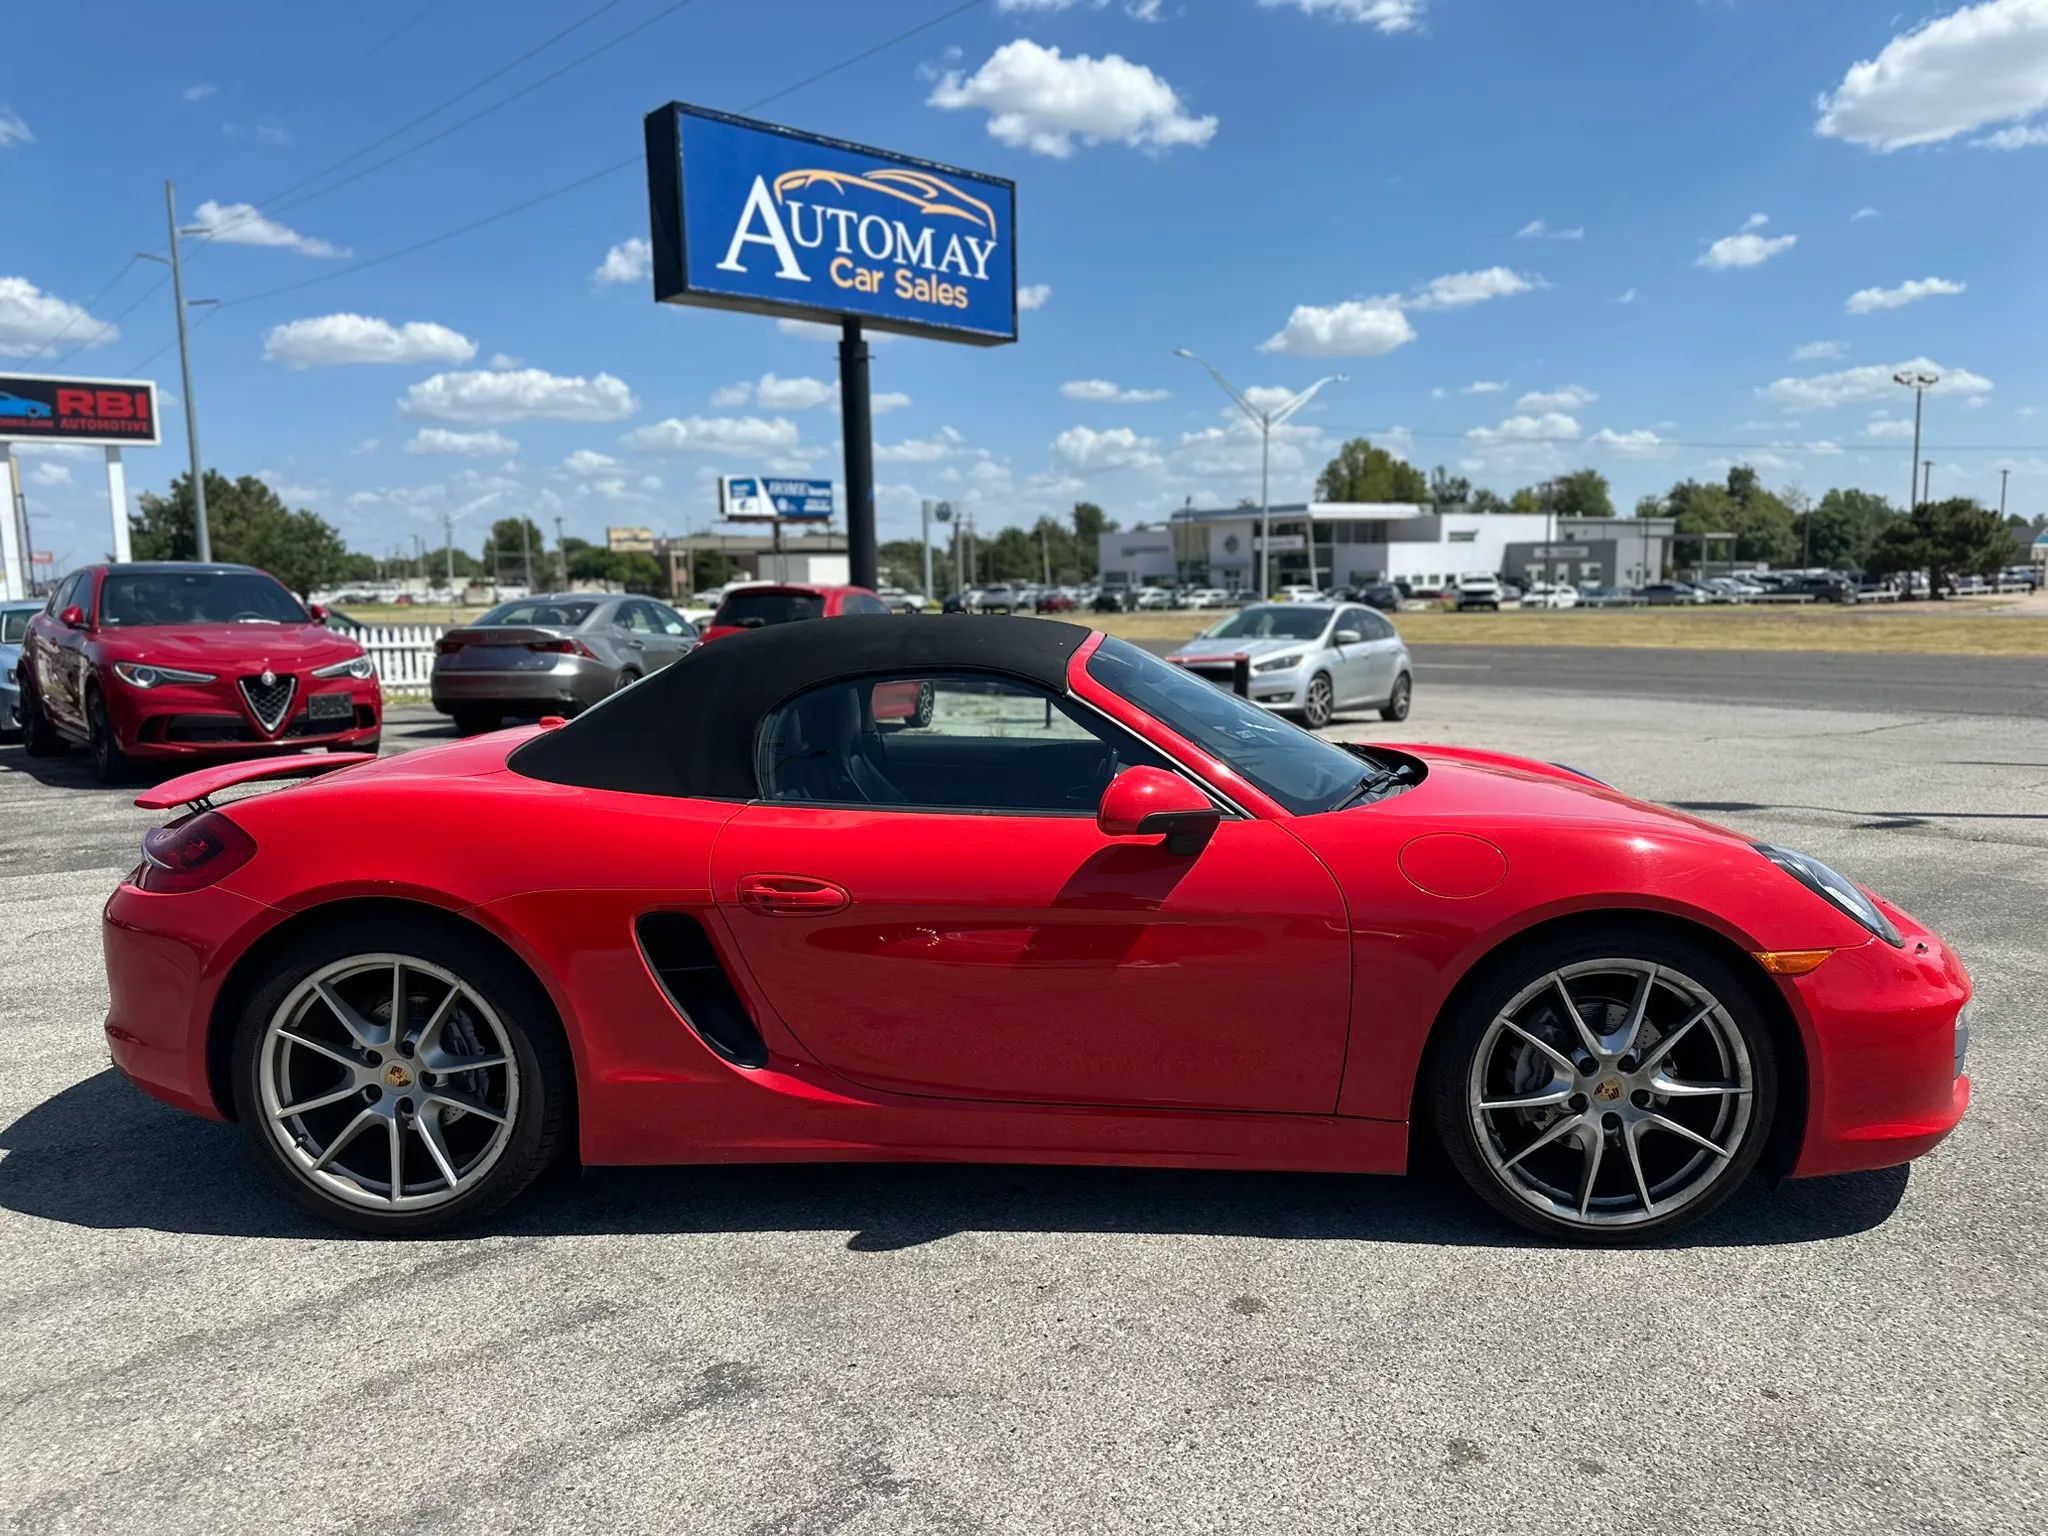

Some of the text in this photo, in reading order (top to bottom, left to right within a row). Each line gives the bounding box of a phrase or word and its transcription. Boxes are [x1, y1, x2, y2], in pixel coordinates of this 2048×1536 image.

[716, 175, 997, 282] AUTOMAY
[829, 257, 968, 309] Car Sales
[56, 388, 149, 419] RBI
[60, 418, 149, 433] AUTOMOTIVE
